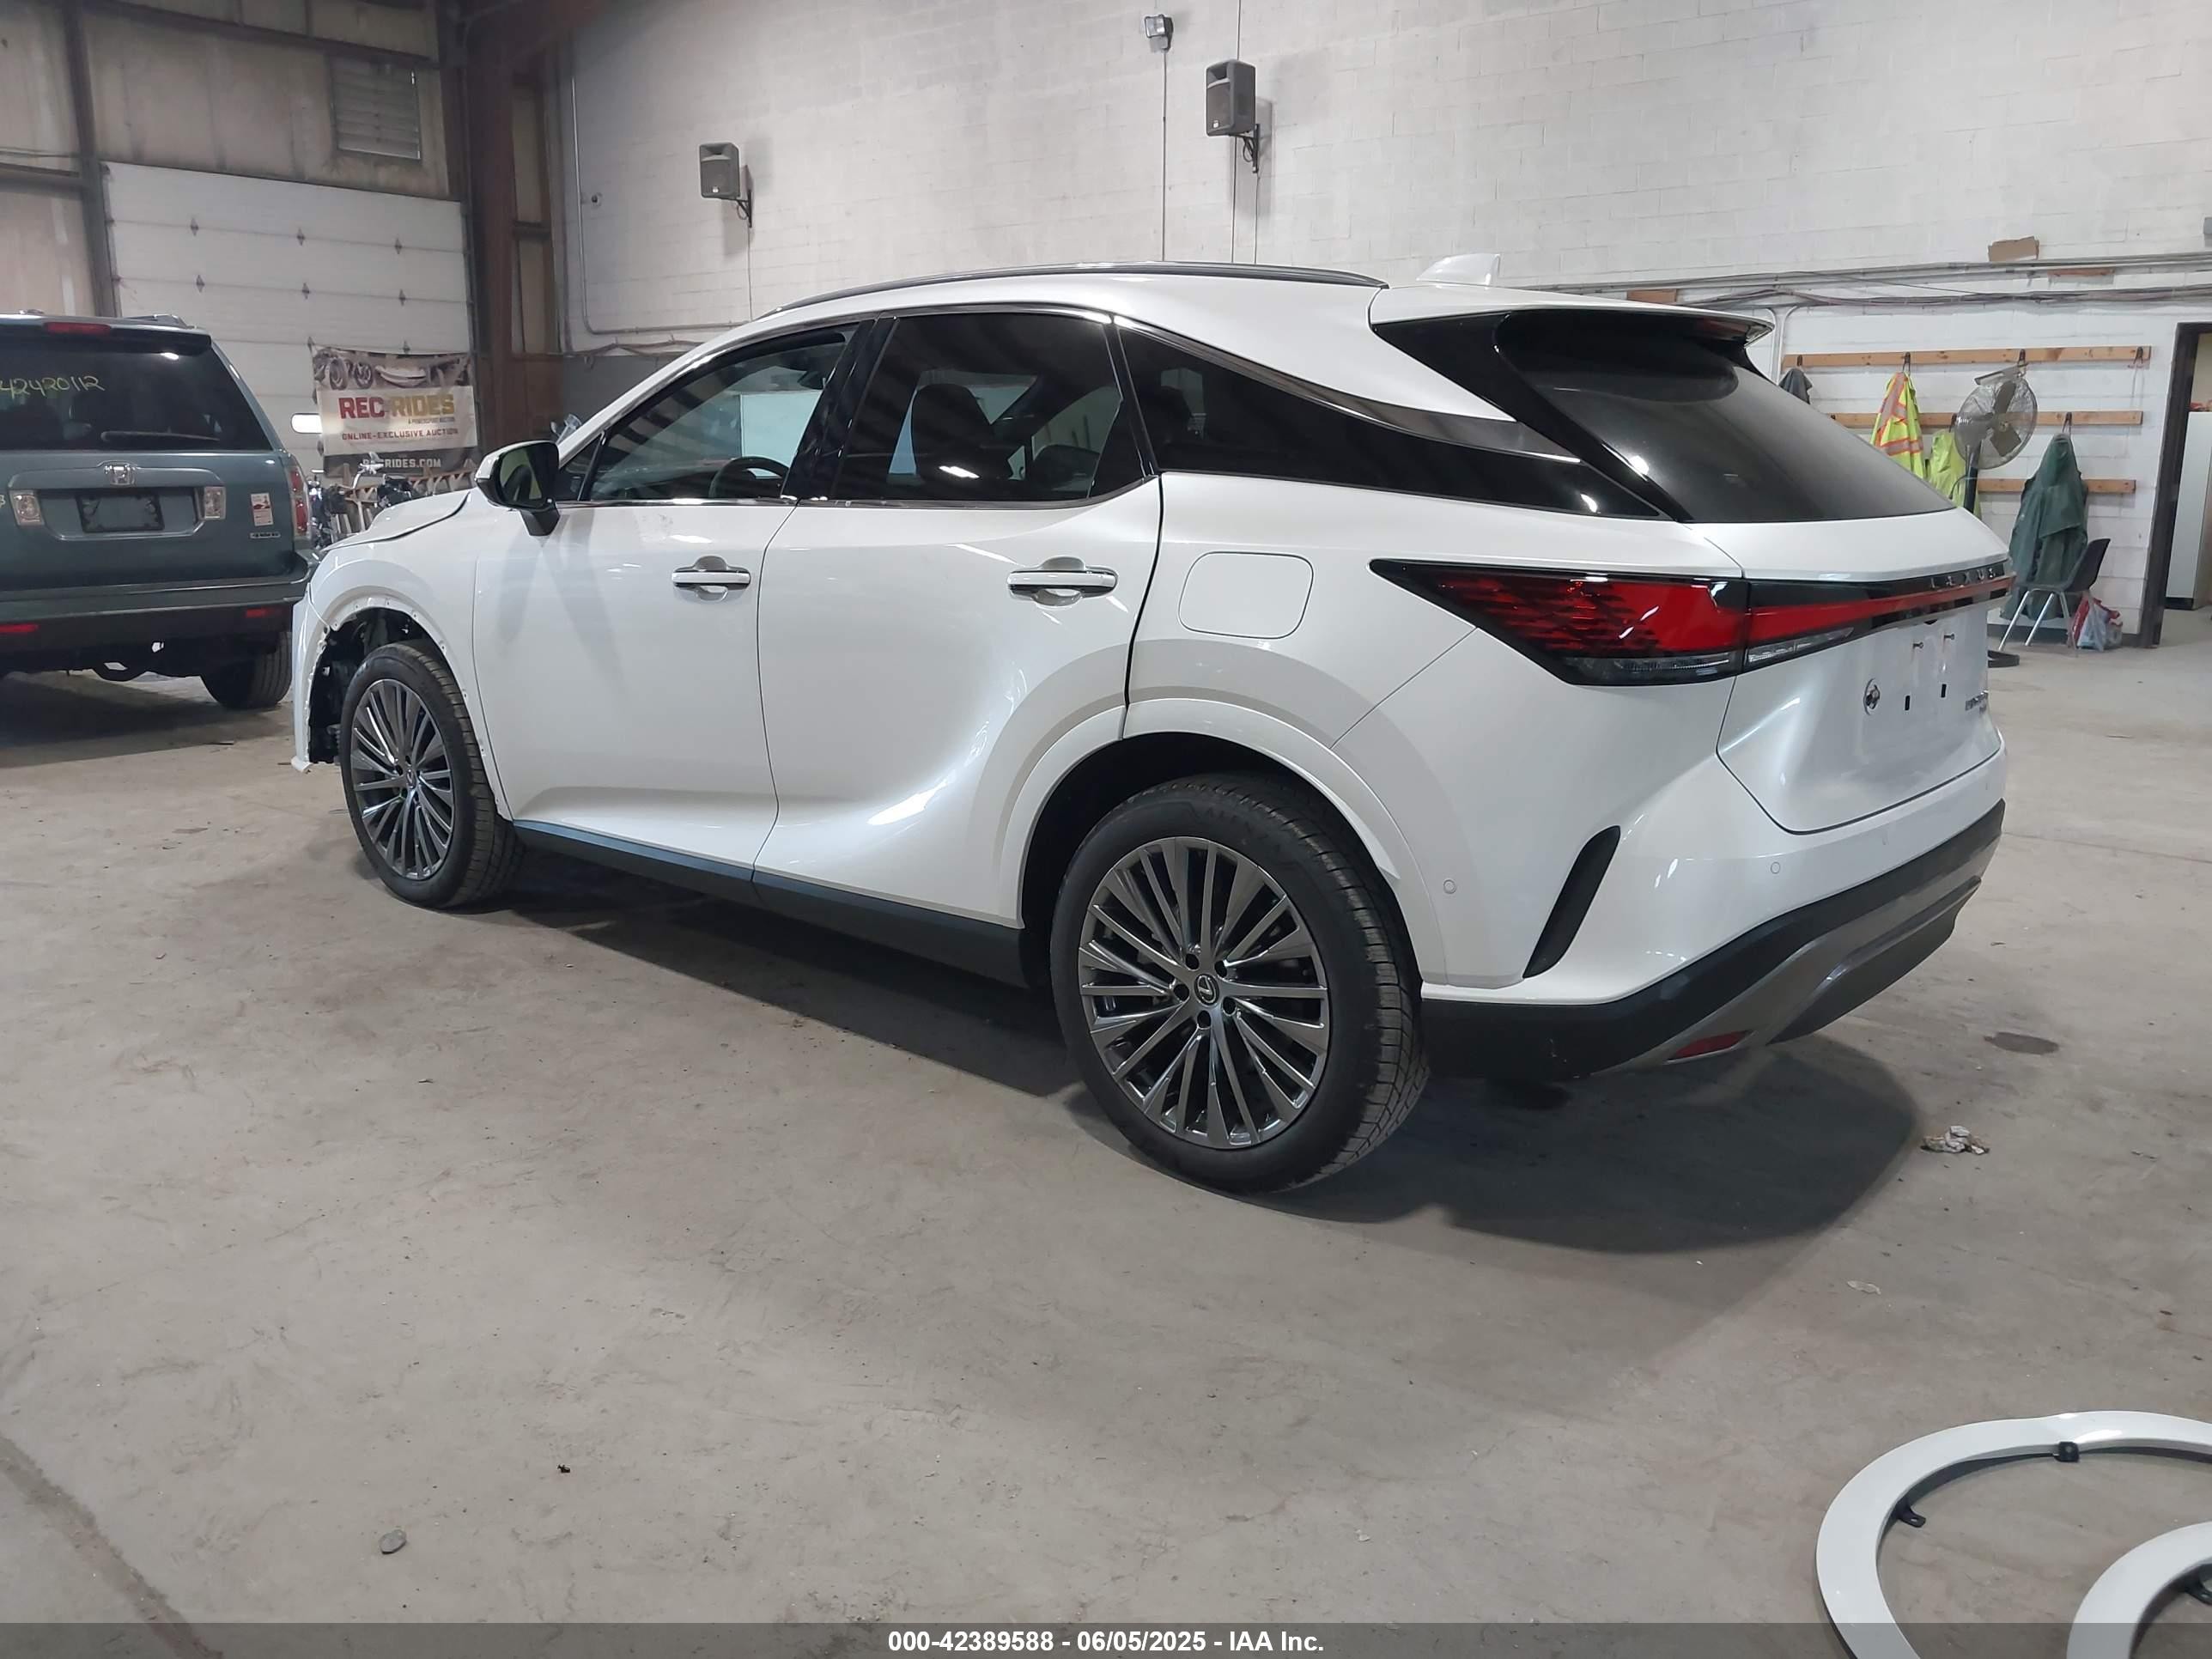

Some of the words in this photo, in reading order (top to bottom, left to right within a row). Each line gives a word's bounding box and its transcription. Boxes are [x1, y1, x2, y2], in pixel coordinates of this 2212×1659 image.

[338, 397, 386, 419] REC
[389, 394, 455, 417] RIDES
[342, 429, 423, 441] ONLINE-EXCLUSIVE
[426, 428, 459, 436] AUCTION
